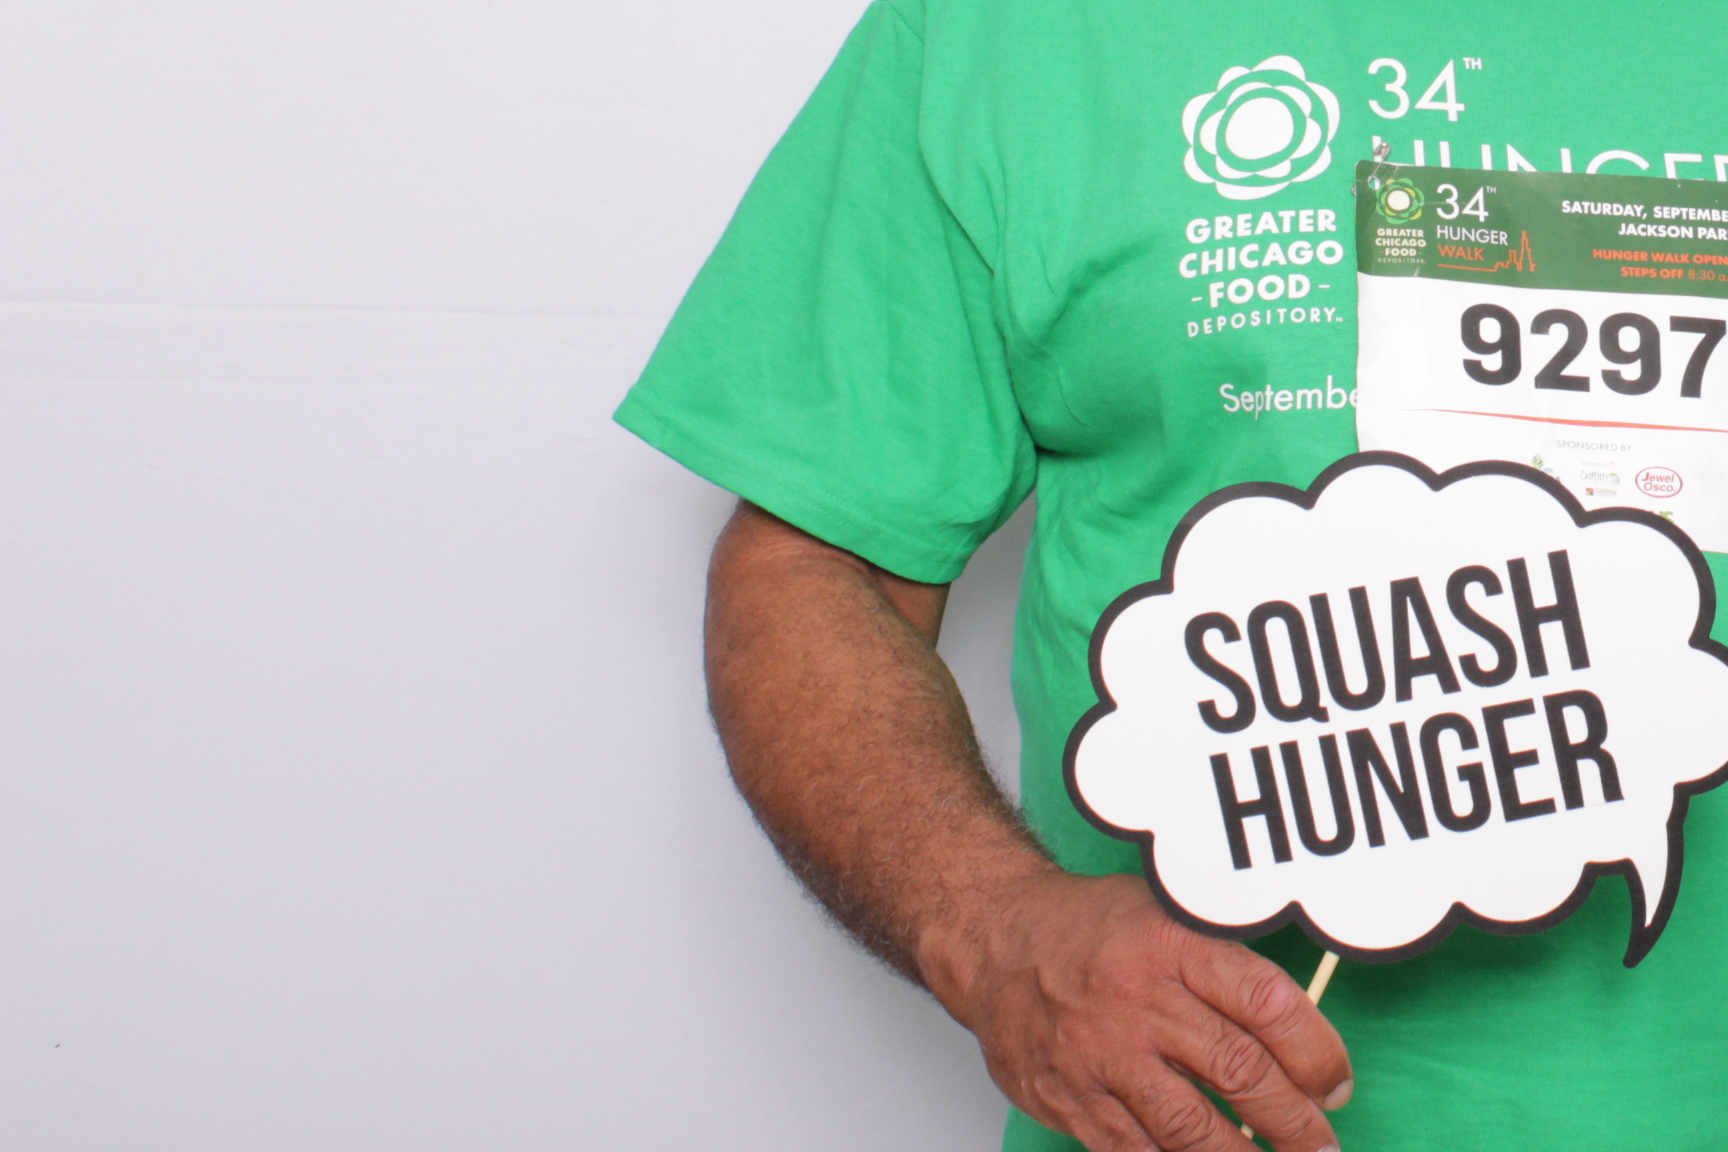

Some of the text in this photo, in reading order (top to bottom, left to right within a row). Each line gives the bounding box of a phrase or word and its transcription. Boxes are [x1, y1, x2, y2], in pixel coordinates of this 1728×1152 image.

[1561, 200, 1648, 220] SATURDAY,
[1185, 209, 1337, 244] GREATER
[1377, 228, 1424, 238] GREATER
[1436, 225, 1509, 246] HUNGER
[1618, 223, 1694, 239] JACKSON
[1375, 237, 1427, 248] CHICAGO
[1437, 243, 1485, 261] WALK
[1178, 239, 1344, 279] CHICAGO
[1592, 249, 1649, 263] HUNGER
[1650, 252, 1691, 265] WALK
[1620, 266, 1657, 279] STEPS
[1659, 268, 1684, 280] OFF
[1687, 269, 1715, 282] 8:30
[1460, 303, 1727, 399] 9297
[1219, 374, 1358, 421] Septemb
[1556, 439, 1632, 453] SPONSORED BY
[1641, 471, 1675, 484] Jewel
[1183, 548, 1591, 734] SQUASH
[1208, 689, 1625, 871] HUNGER
